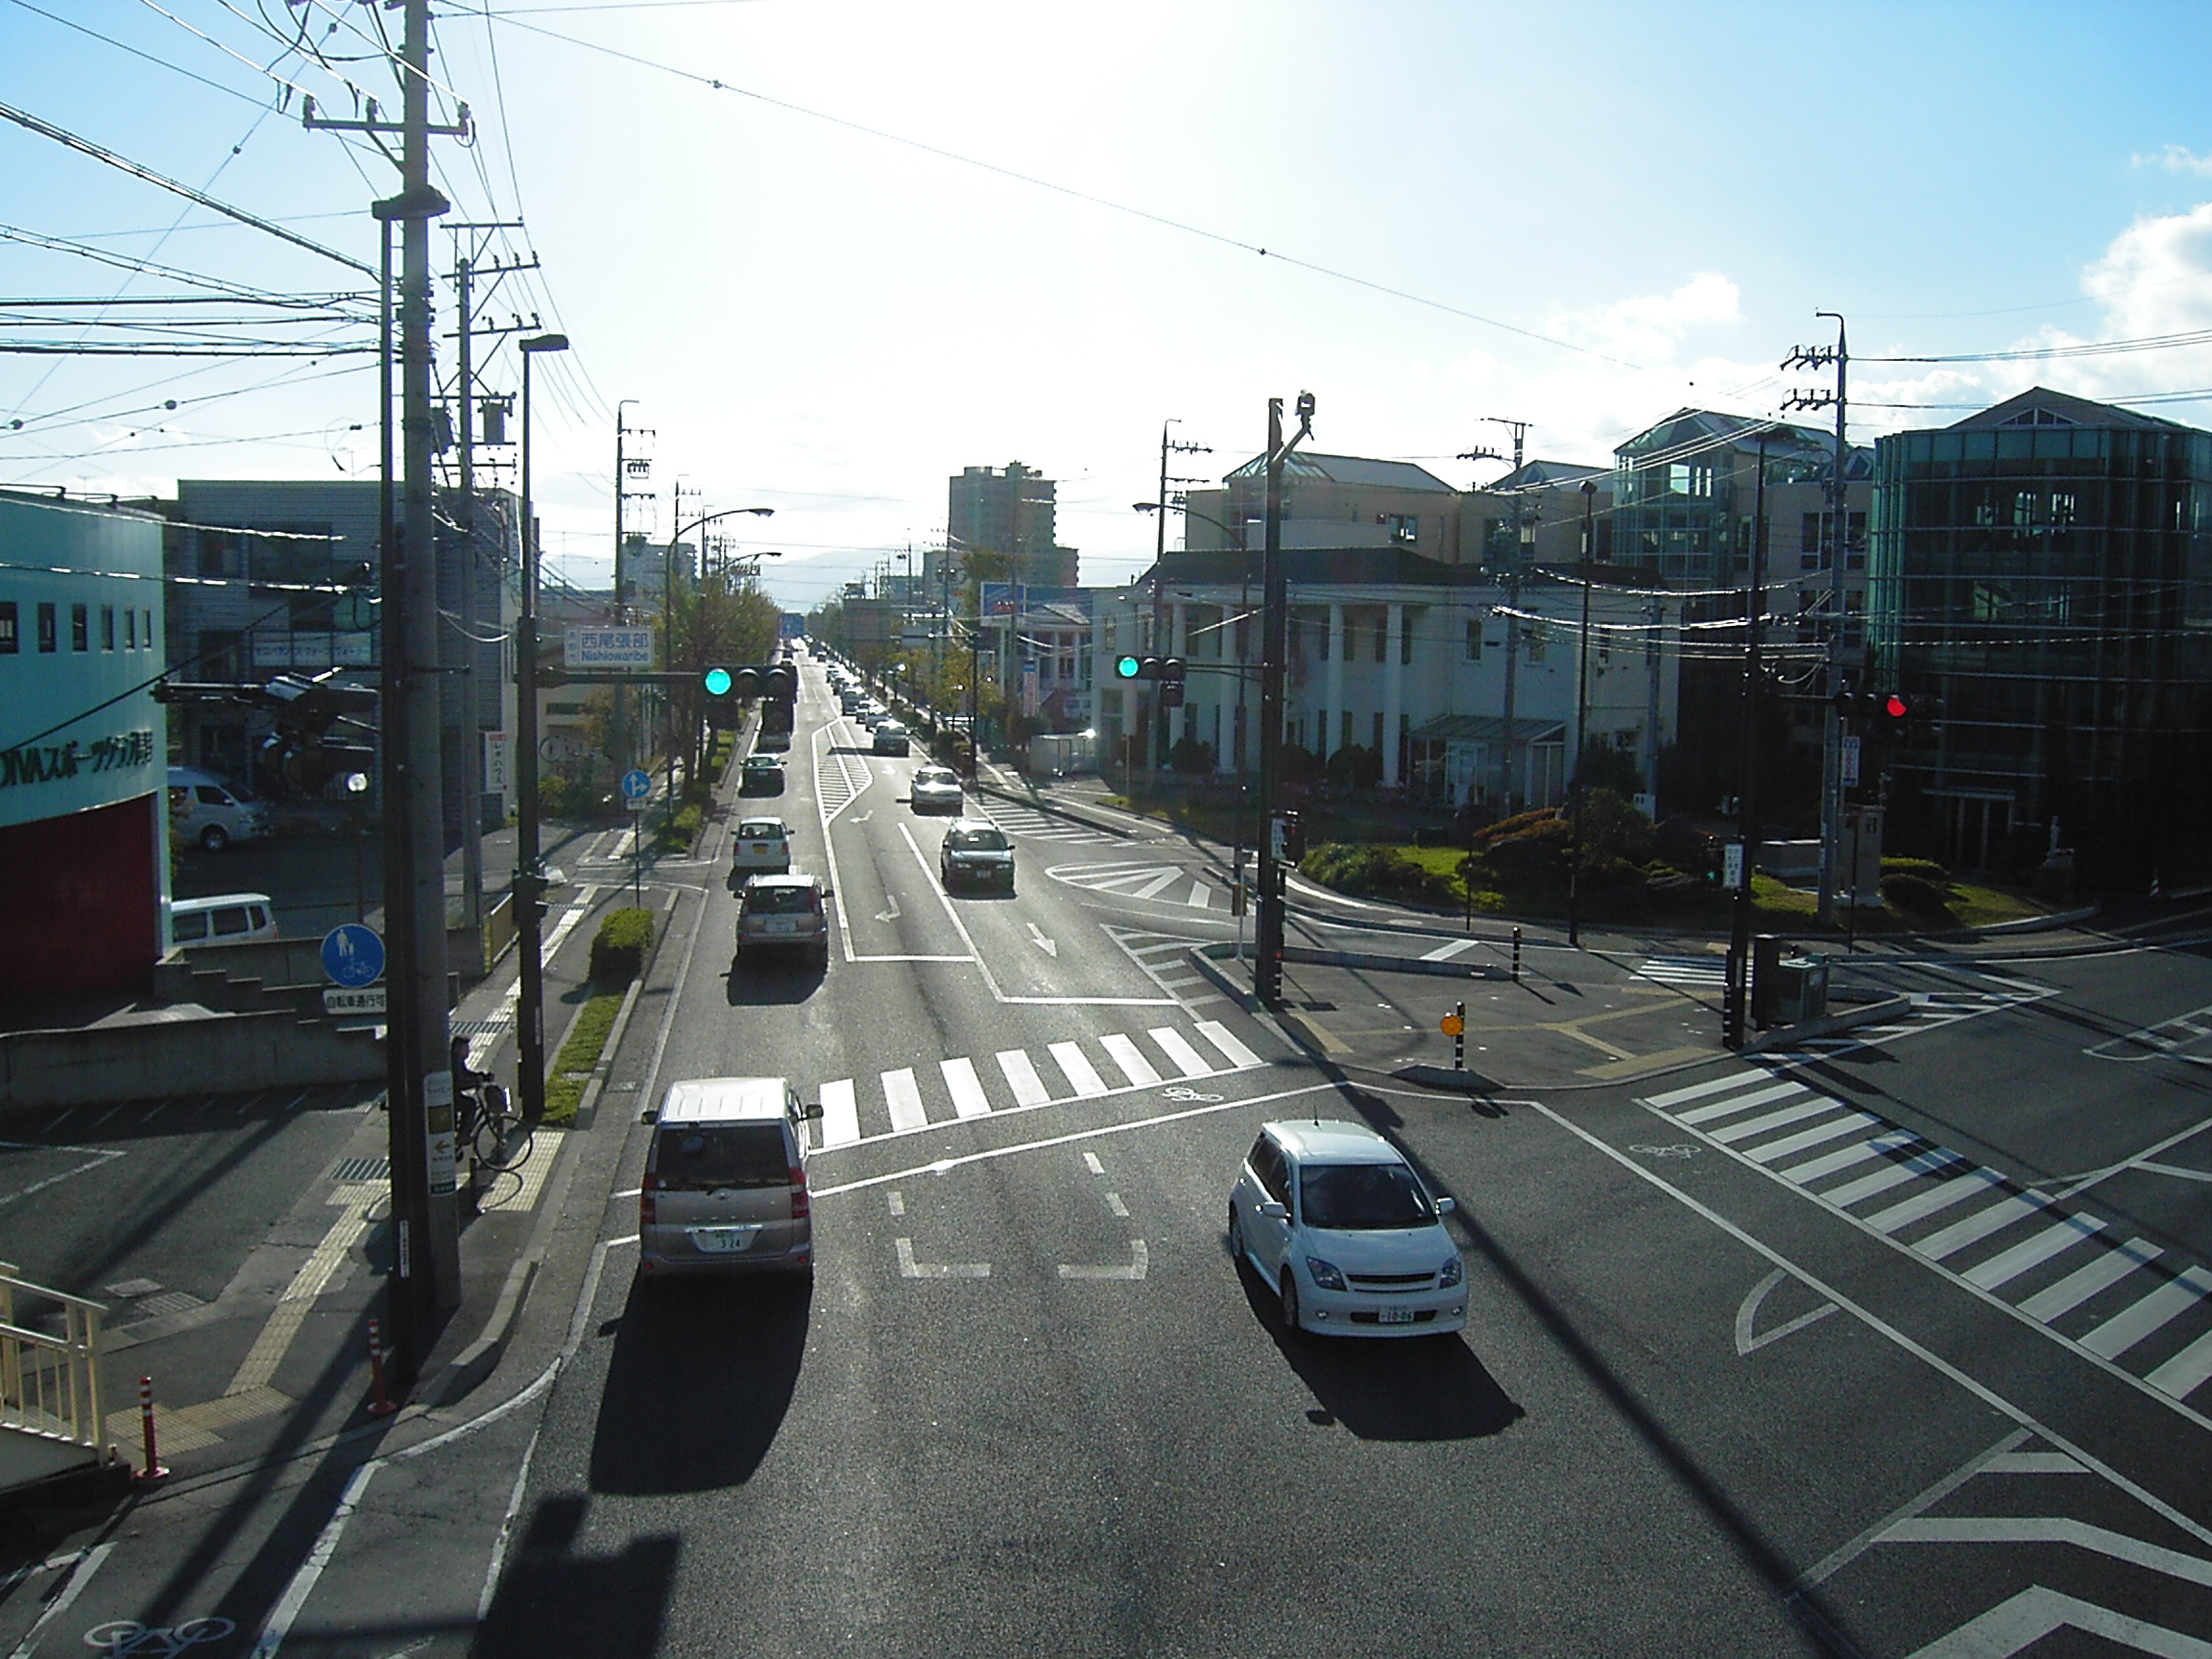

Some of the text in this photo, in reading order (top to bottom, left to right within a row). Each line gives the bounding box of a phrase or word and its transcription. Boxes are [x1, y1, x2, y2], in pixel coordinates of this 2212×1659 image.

[582, 651, 648, 661] Nishiowaribe
[326, 993, 385, 1008] 自転車通行可
